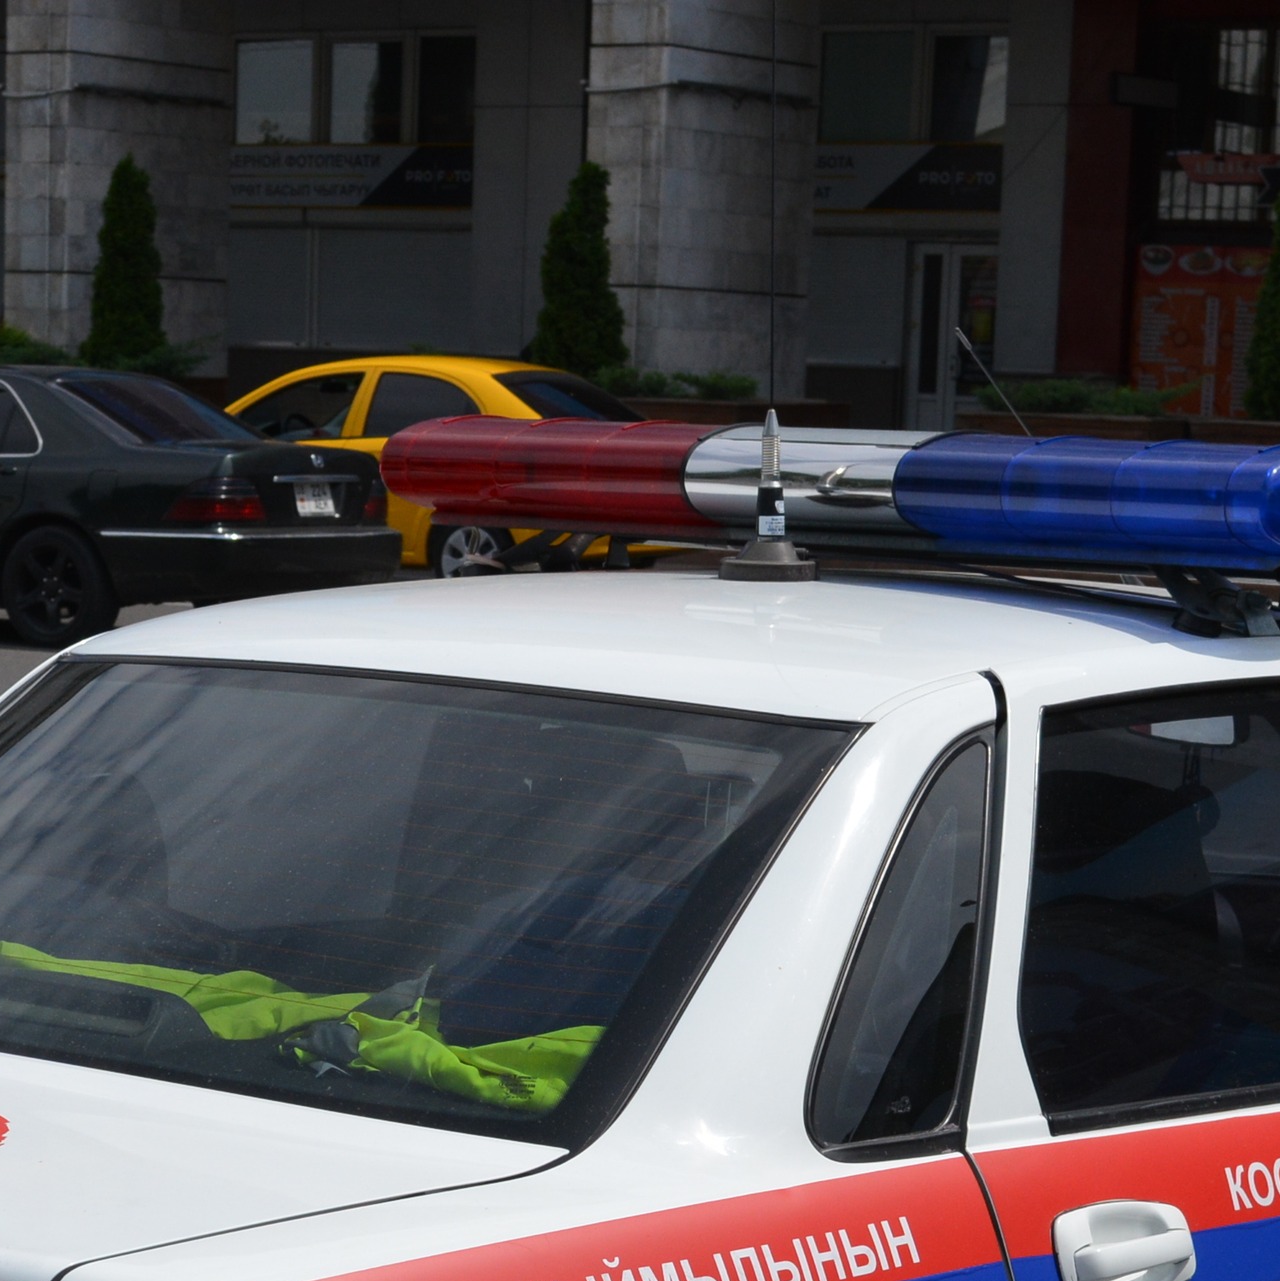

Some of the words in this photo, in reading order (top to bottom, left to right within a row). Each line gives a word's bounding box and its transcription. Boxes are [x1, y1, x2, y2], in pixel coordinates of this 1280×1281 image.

[284, 153, 382, 168] ФОТОПЕЧАТИ
[405, 169, 433, 183] PRO
[918, 171, 951, 185] PRO
